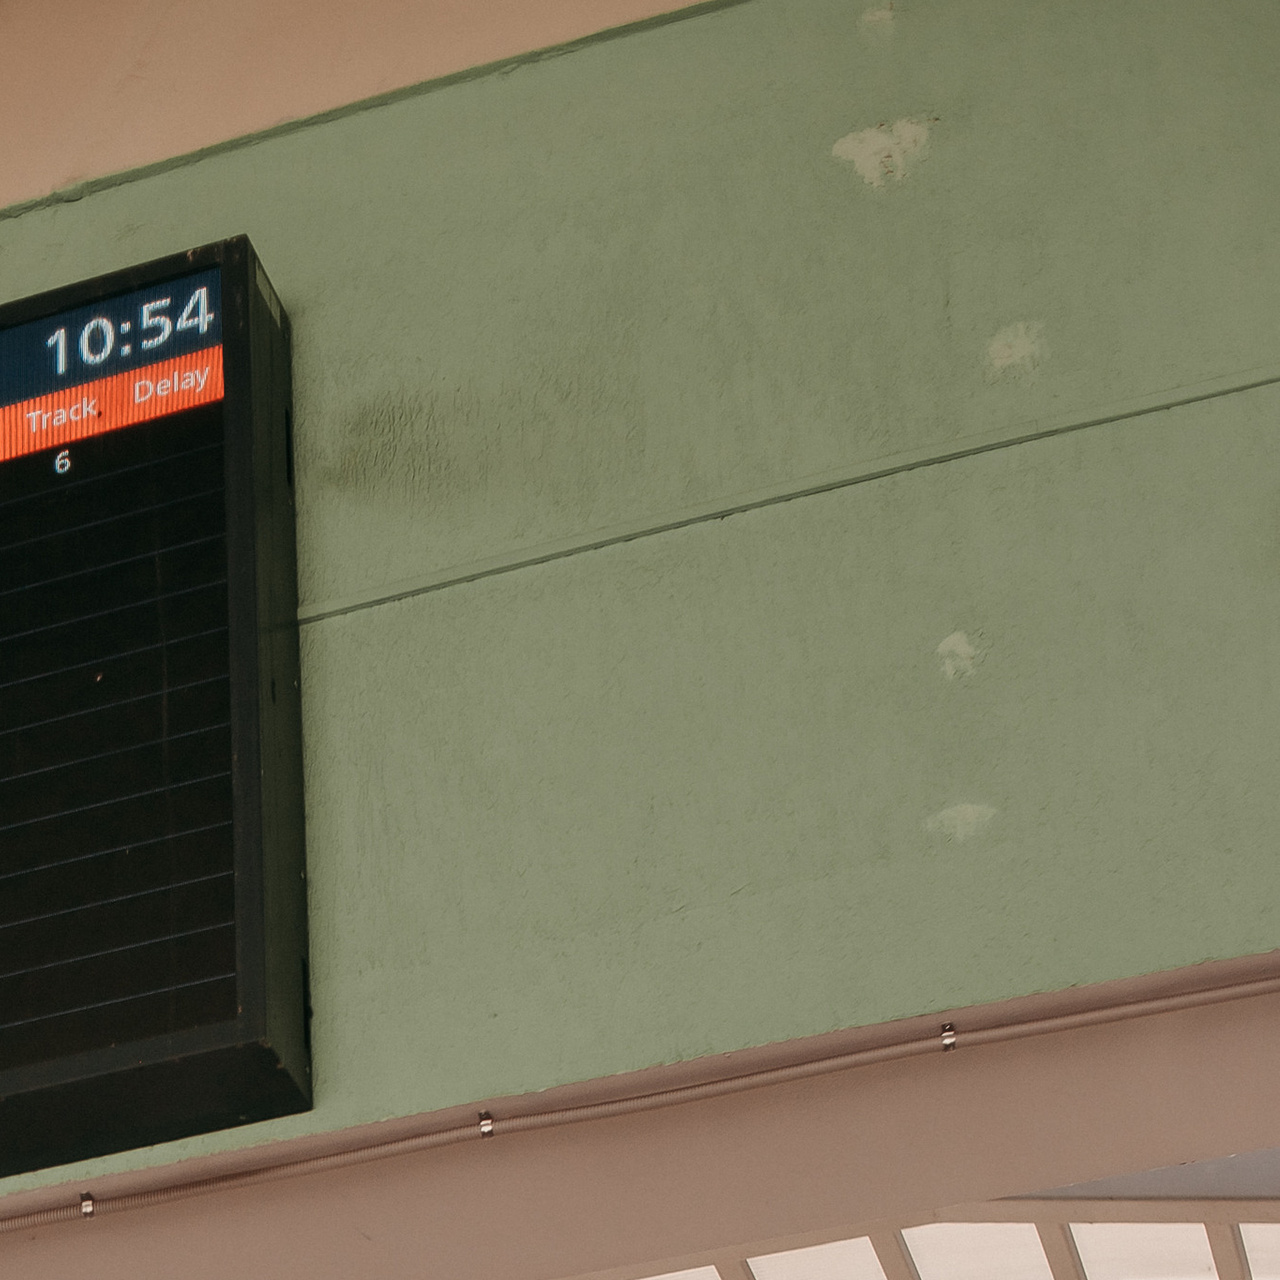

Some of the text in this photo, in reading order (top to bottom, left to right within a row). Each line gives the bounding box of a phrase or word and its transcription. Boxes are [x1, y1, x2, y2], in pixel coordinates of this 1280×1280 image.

[46, 286, 214, 376] 10:54
[25, 396, 98, 433] Track
[134, 366, 210, 404] Delay
[54, 449, 71, 475] 6
